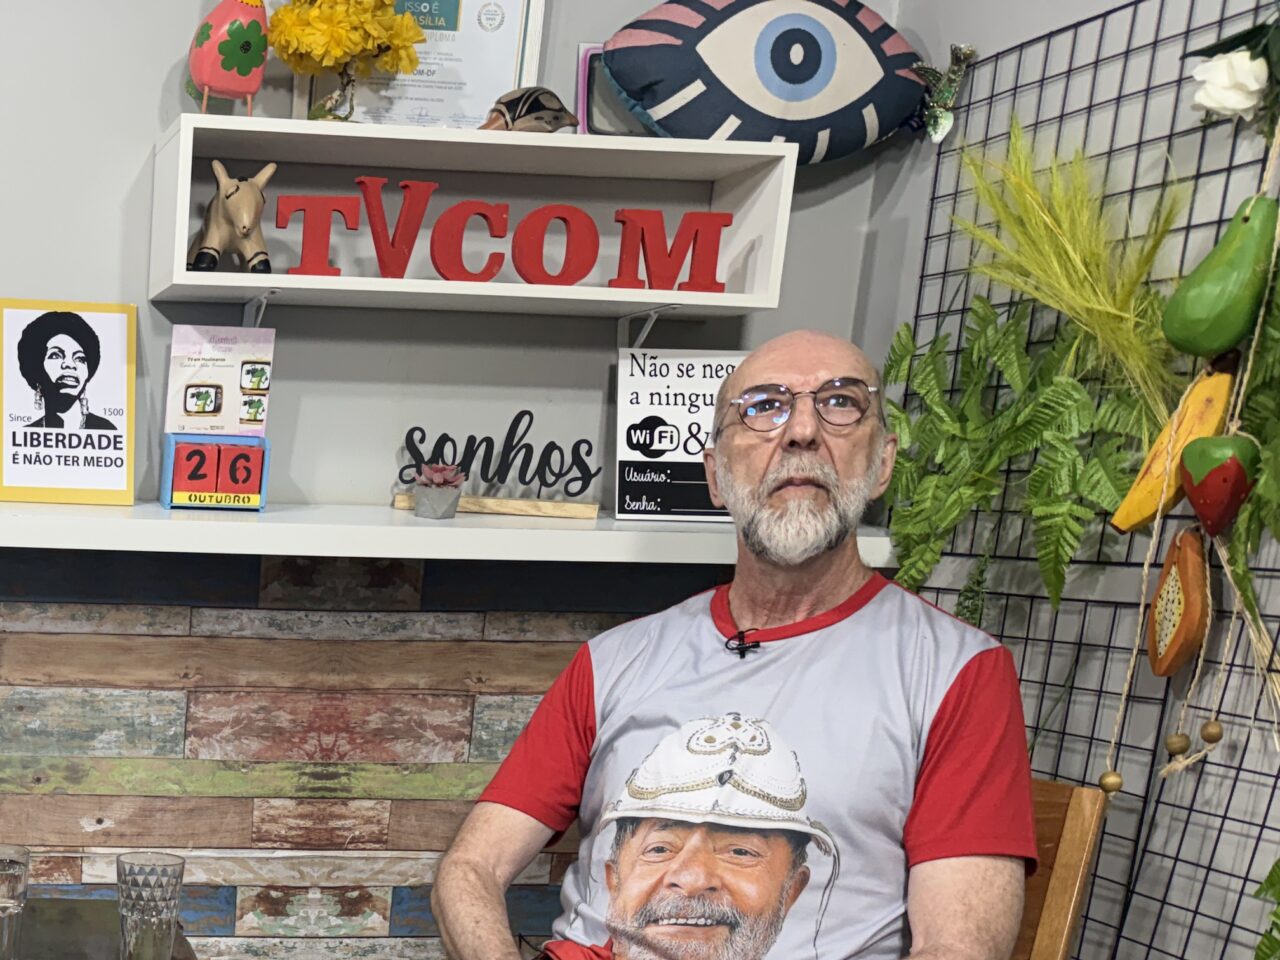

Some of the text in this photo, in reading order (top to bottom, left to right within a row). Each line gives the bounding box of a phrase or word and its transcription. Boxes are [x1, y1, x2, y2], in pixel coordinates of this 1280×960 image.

[425, 31, 456, 42] IPLOMA
[276, 176, 733, 292] TVCOM
[629, 353, 736, 378] Não se neg
[629, 385, 715, 414] a ningu
[8, 407, 124, 422] Since 1500
[12, 431, 124, 451] LIBERDADE
[12, 451, 124, 468] É NÃO TER MEDO
[399, 410, 602, 499] sonhos
[625, 466, 671, 483] Usuário:
[188, 493, 251, 505] OUTUBRO
[624, 495, 661, 511] Senha:
